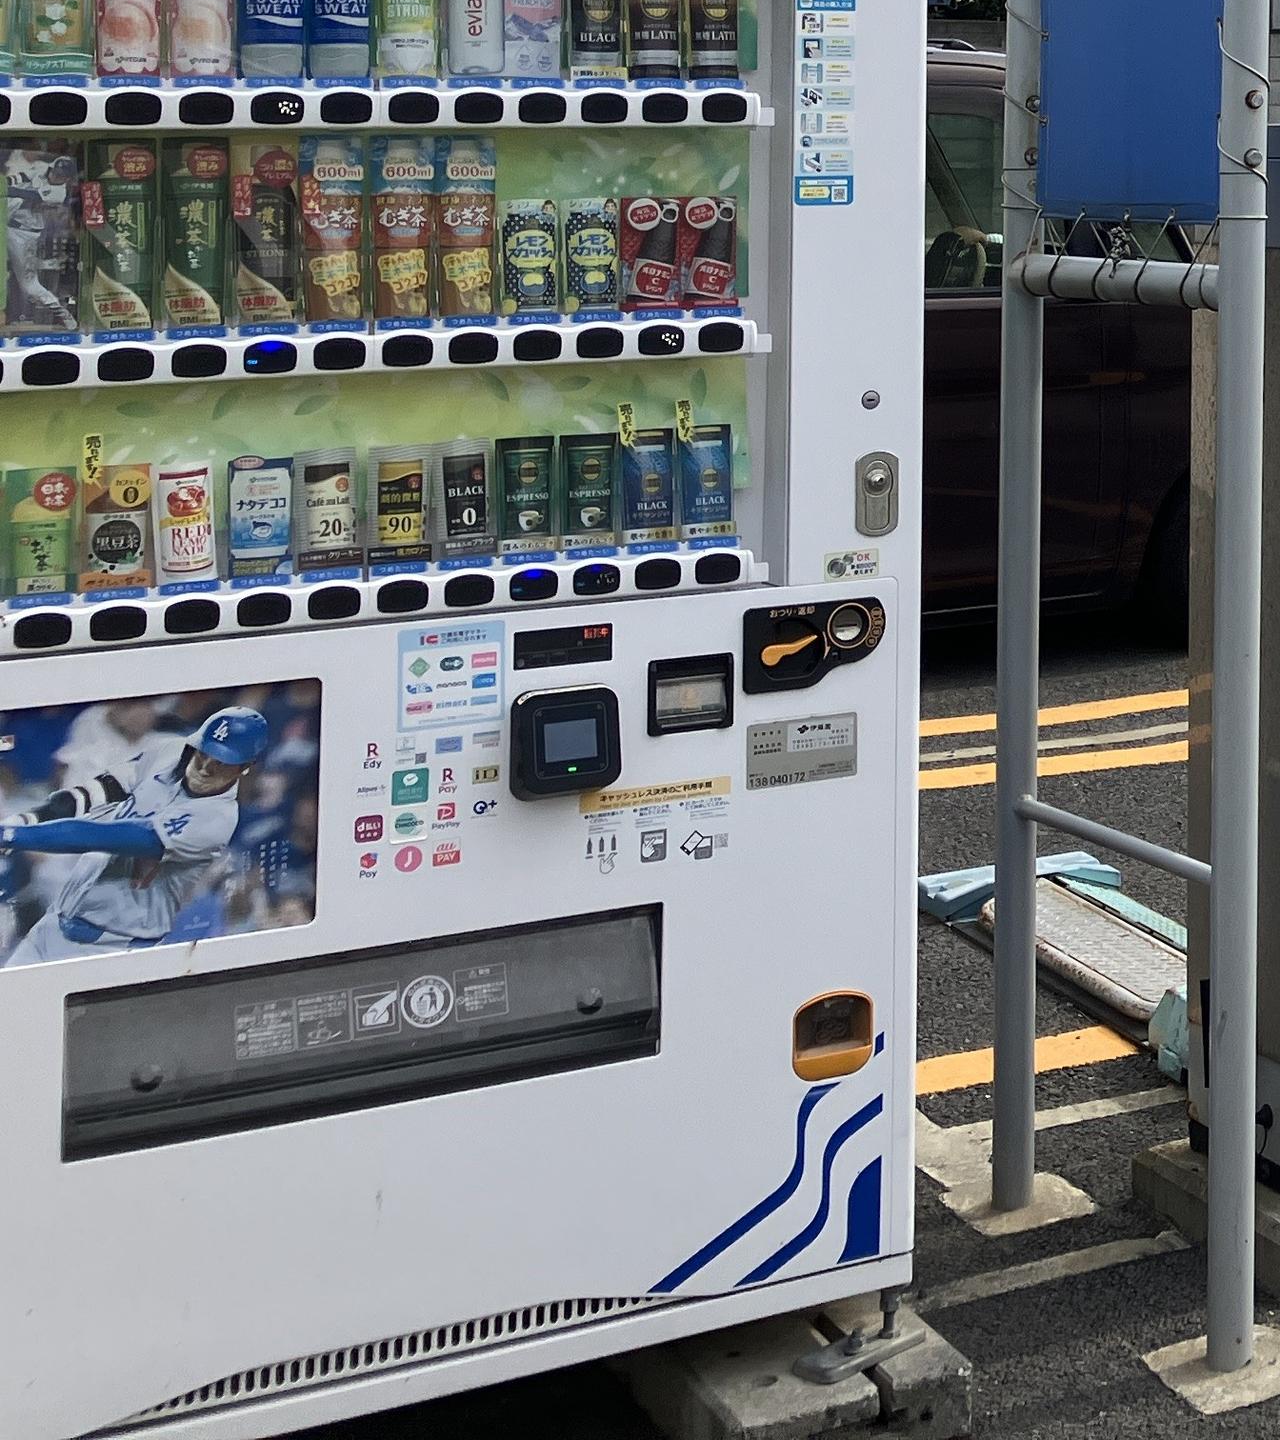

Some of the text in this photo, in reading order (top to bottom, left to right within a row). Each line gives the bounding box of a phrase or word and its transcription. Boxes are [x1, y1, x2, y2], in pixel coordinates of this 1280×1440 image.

[246, 4, 300, 15] SWEAT
[314, 4, 367, 14] SWEAT
[580, 32, 616, 43] BLACK
[317, 166, 362, 178] 600ml
[385, 165, 431, 178] 600ml
[450, 165, 493, 177] 600ml
[311, 207, 358, 229] むぎ茶
[379, 205, 427, 227] むぎ茶
[443, 205, 490, 227] むぎ茶
[516, 235, 549, 247] レモン
[578, 234, 610, 246] レモン
[98, 301, 136, 314] 体脂肪
[169, 297, 206, 310] 体脂肪
[241, 295, 278, 308] 体脂肪
[448, 485, 484, 498] BLACK
[506, 492, 549, 503] ESPRESSO
[569, 488, 611, 498] ESPRESSO
[236, 497, 287, 512] ナタデココ
[636, 500, 668, 510] BLACK
[695, 496, 726, 506] BLACK
[319, 518, 342, 537] 20
[388, 515, 412, 534] 90
[96, 534, 140, 551] 黒豆茶
[363, 760, 382, 770] Edy
[749, 771, 806, 788] 138 040172
[436, 852, 456, 863] PAY
[359, 870, 378, 879] Pay
